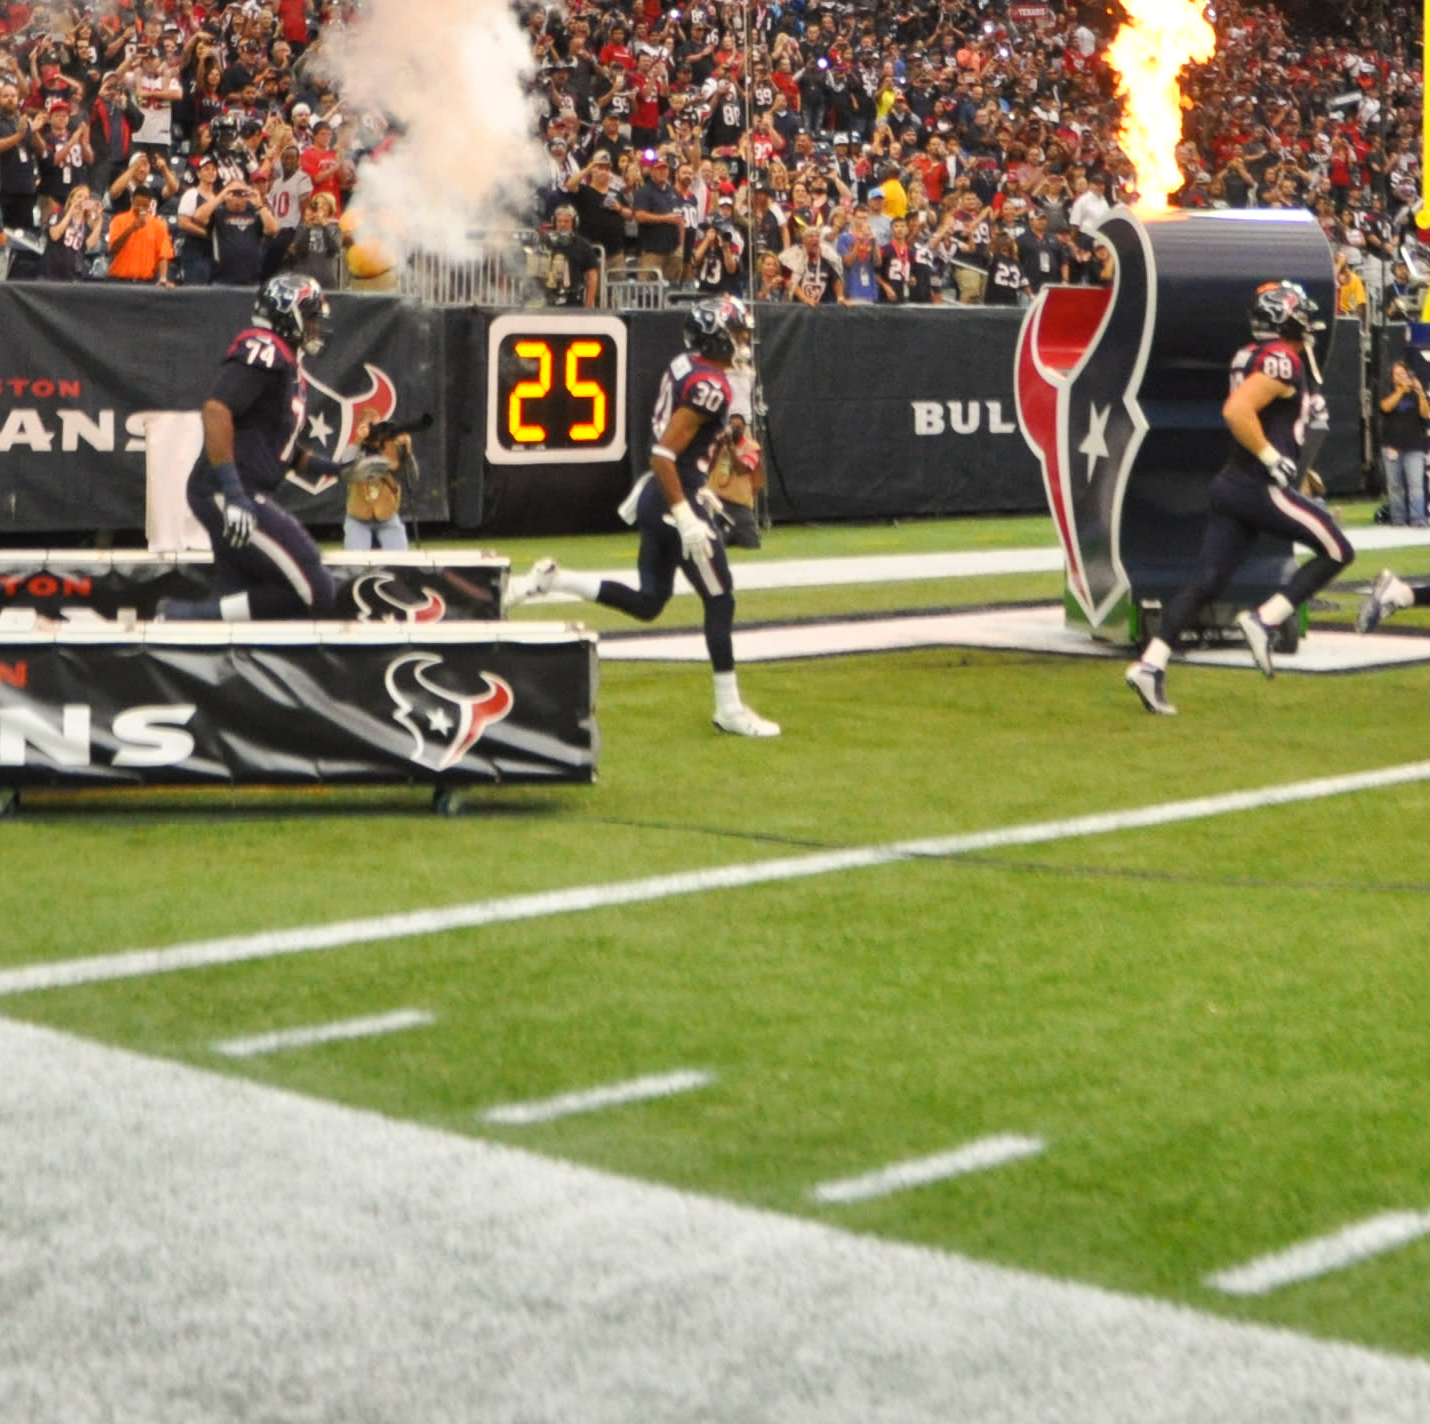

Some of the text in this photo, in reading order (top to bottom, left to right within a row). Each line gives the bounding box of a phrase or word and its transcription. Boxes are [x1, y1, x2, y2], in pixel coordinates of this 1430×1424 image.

[994, 262, 1022, 289] 23
[245, 339, 276, 368] 74
[1263, 356, 1294, 380] 88
[508, 340, 606, 443] 25
[691, 380, 725, 413] 30
